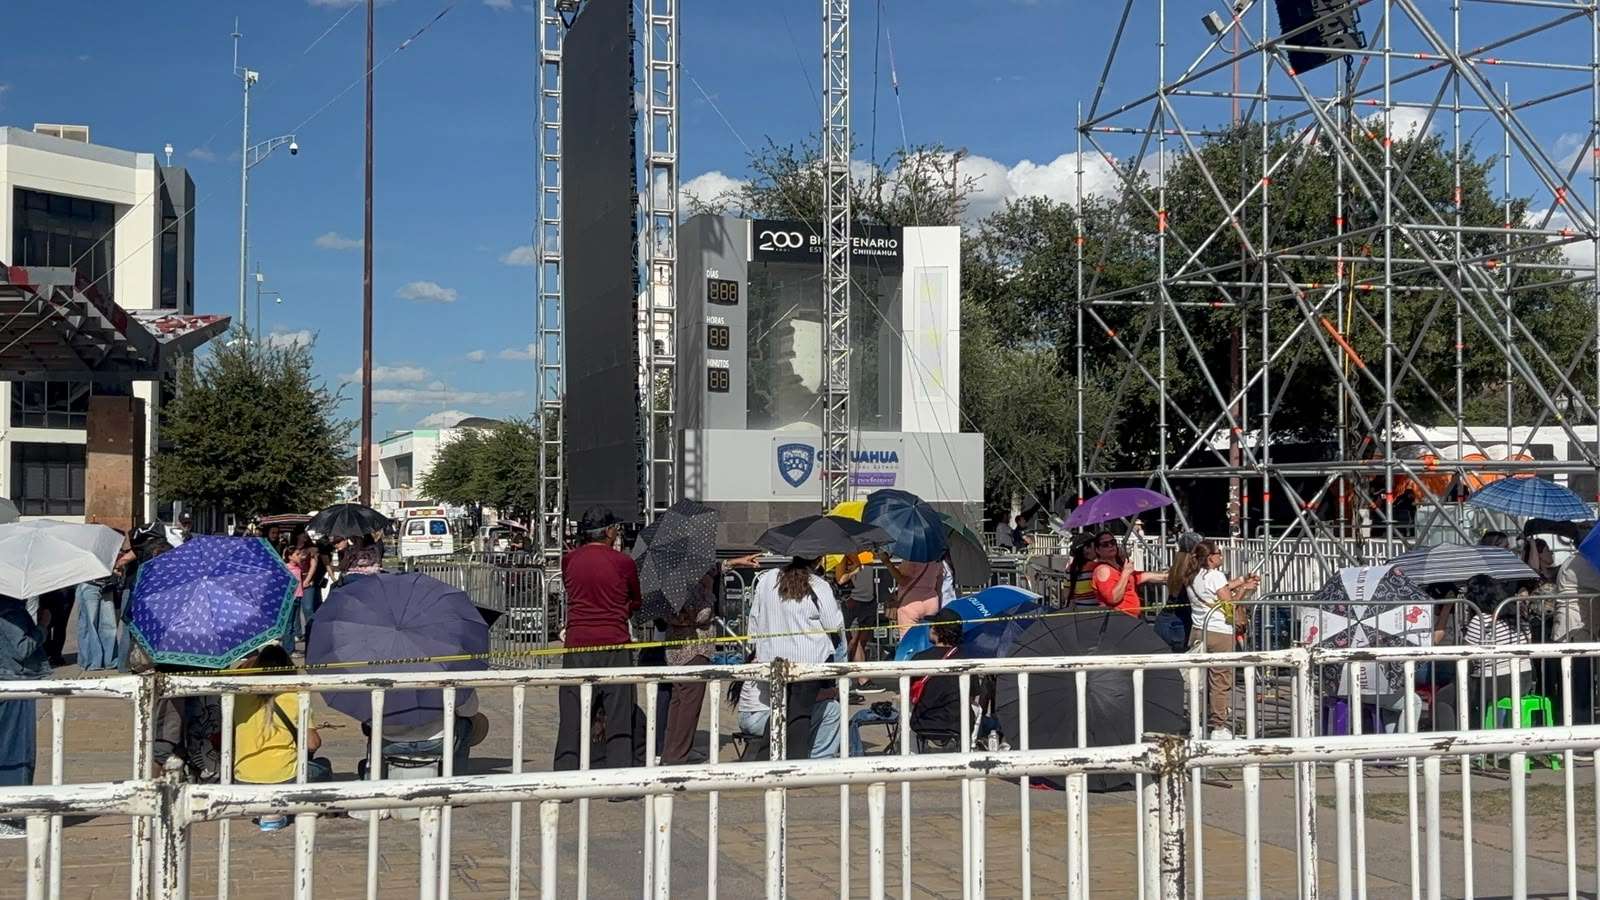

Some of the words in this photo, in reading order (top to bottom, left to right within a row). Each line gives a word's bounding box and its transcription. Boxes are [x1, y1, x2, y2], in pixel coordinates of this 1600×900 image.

[759, 230, 804, 251] 200
[809, 235, 898, 249] BIENARIO
[706, 316, 725, 325] HORAS
[816, 450, 899, 463] CUAHUA
